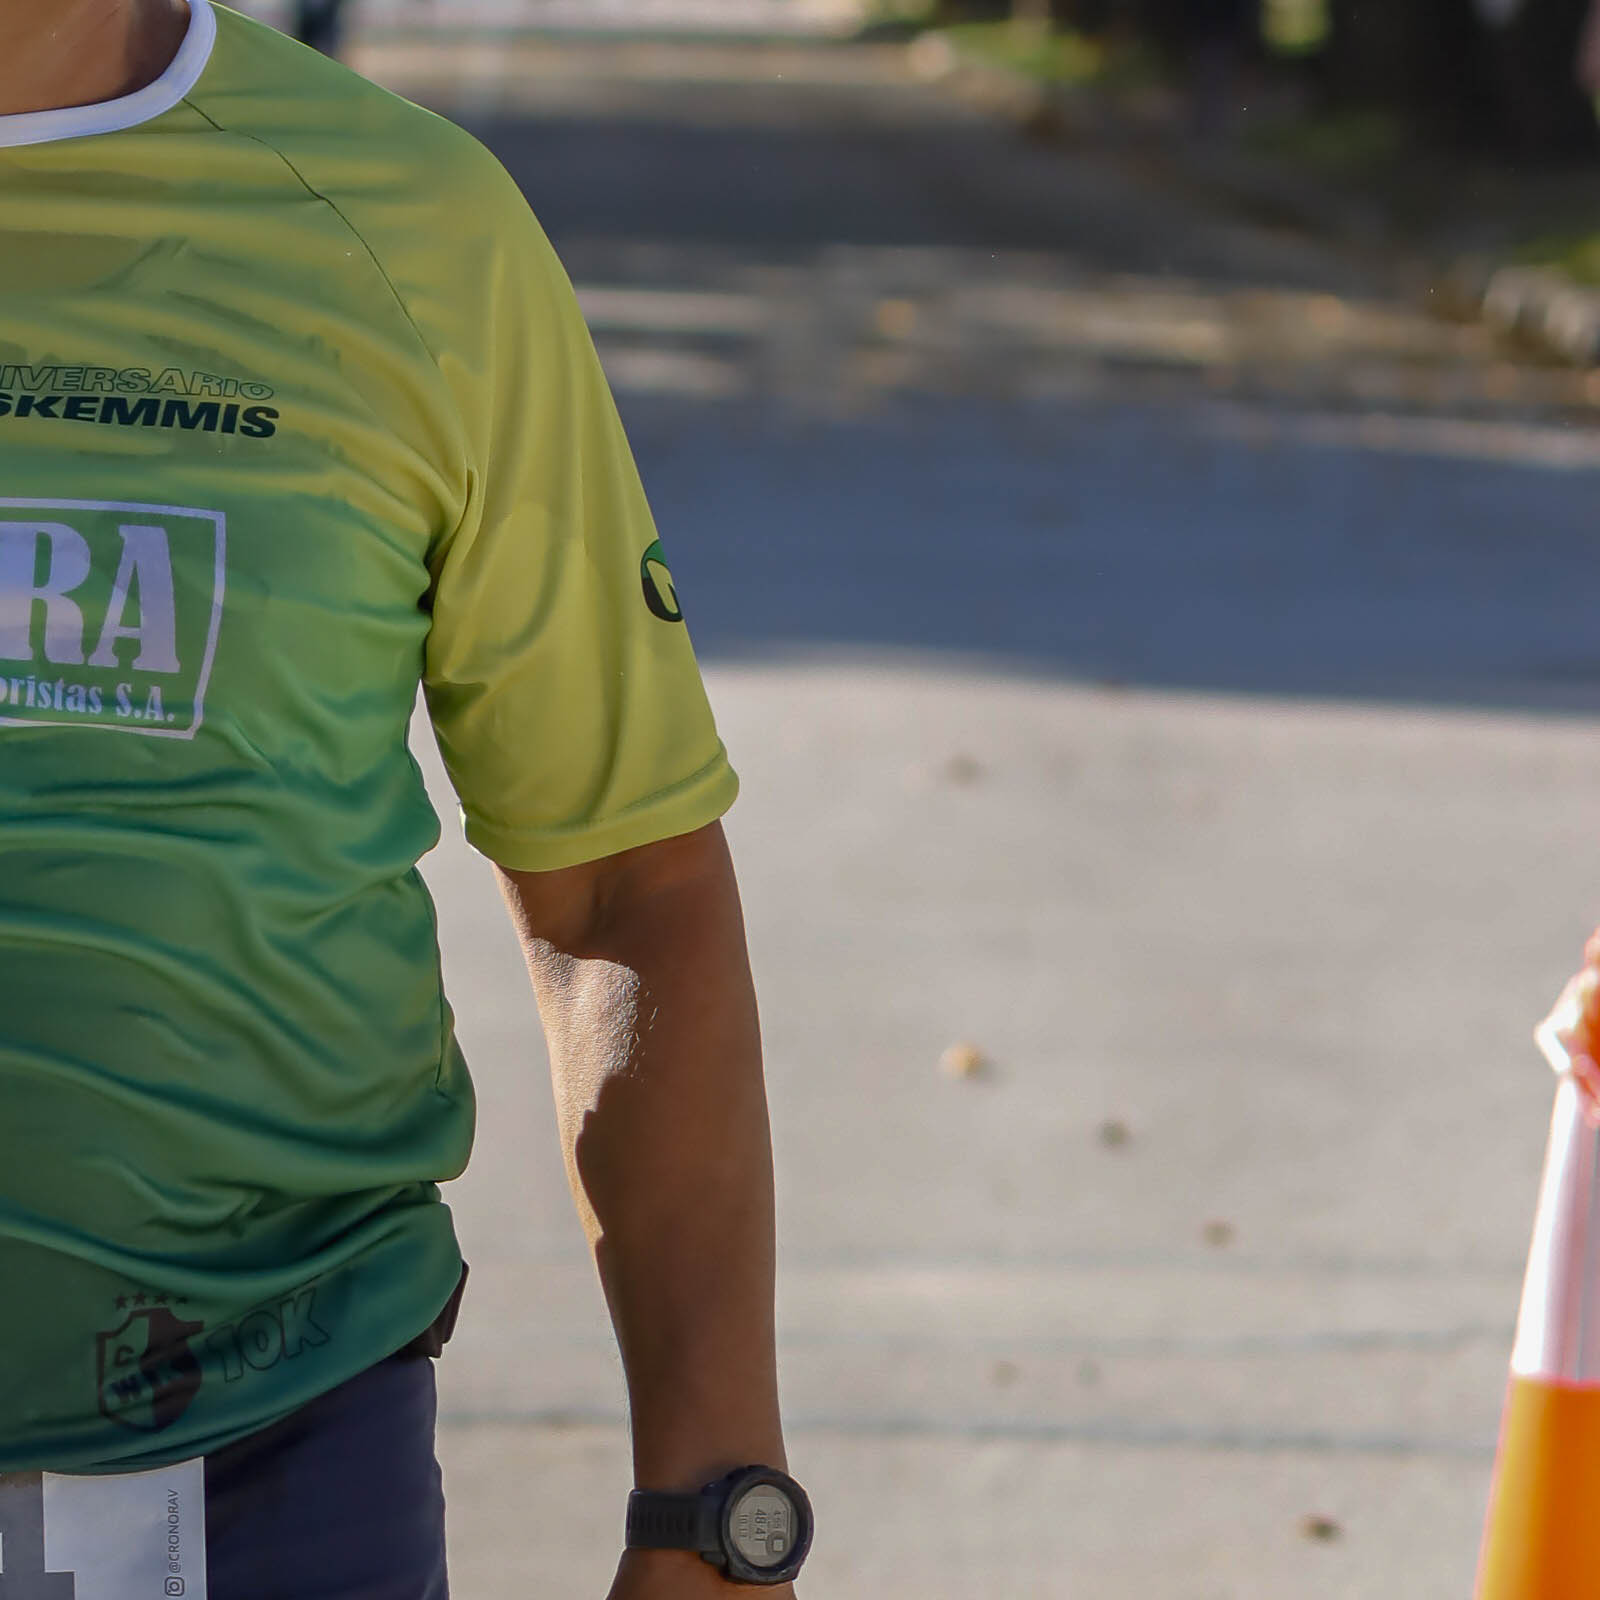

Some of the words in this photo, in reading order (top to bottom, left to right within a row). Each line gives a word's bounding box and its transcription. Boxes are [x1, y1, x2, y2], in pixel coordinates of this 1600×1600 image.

[114, 681, 177, 722] S.A.
[205, 1286, 332, 1384] 10K
[167, 1488, 181, 1574] @CRONORAV
